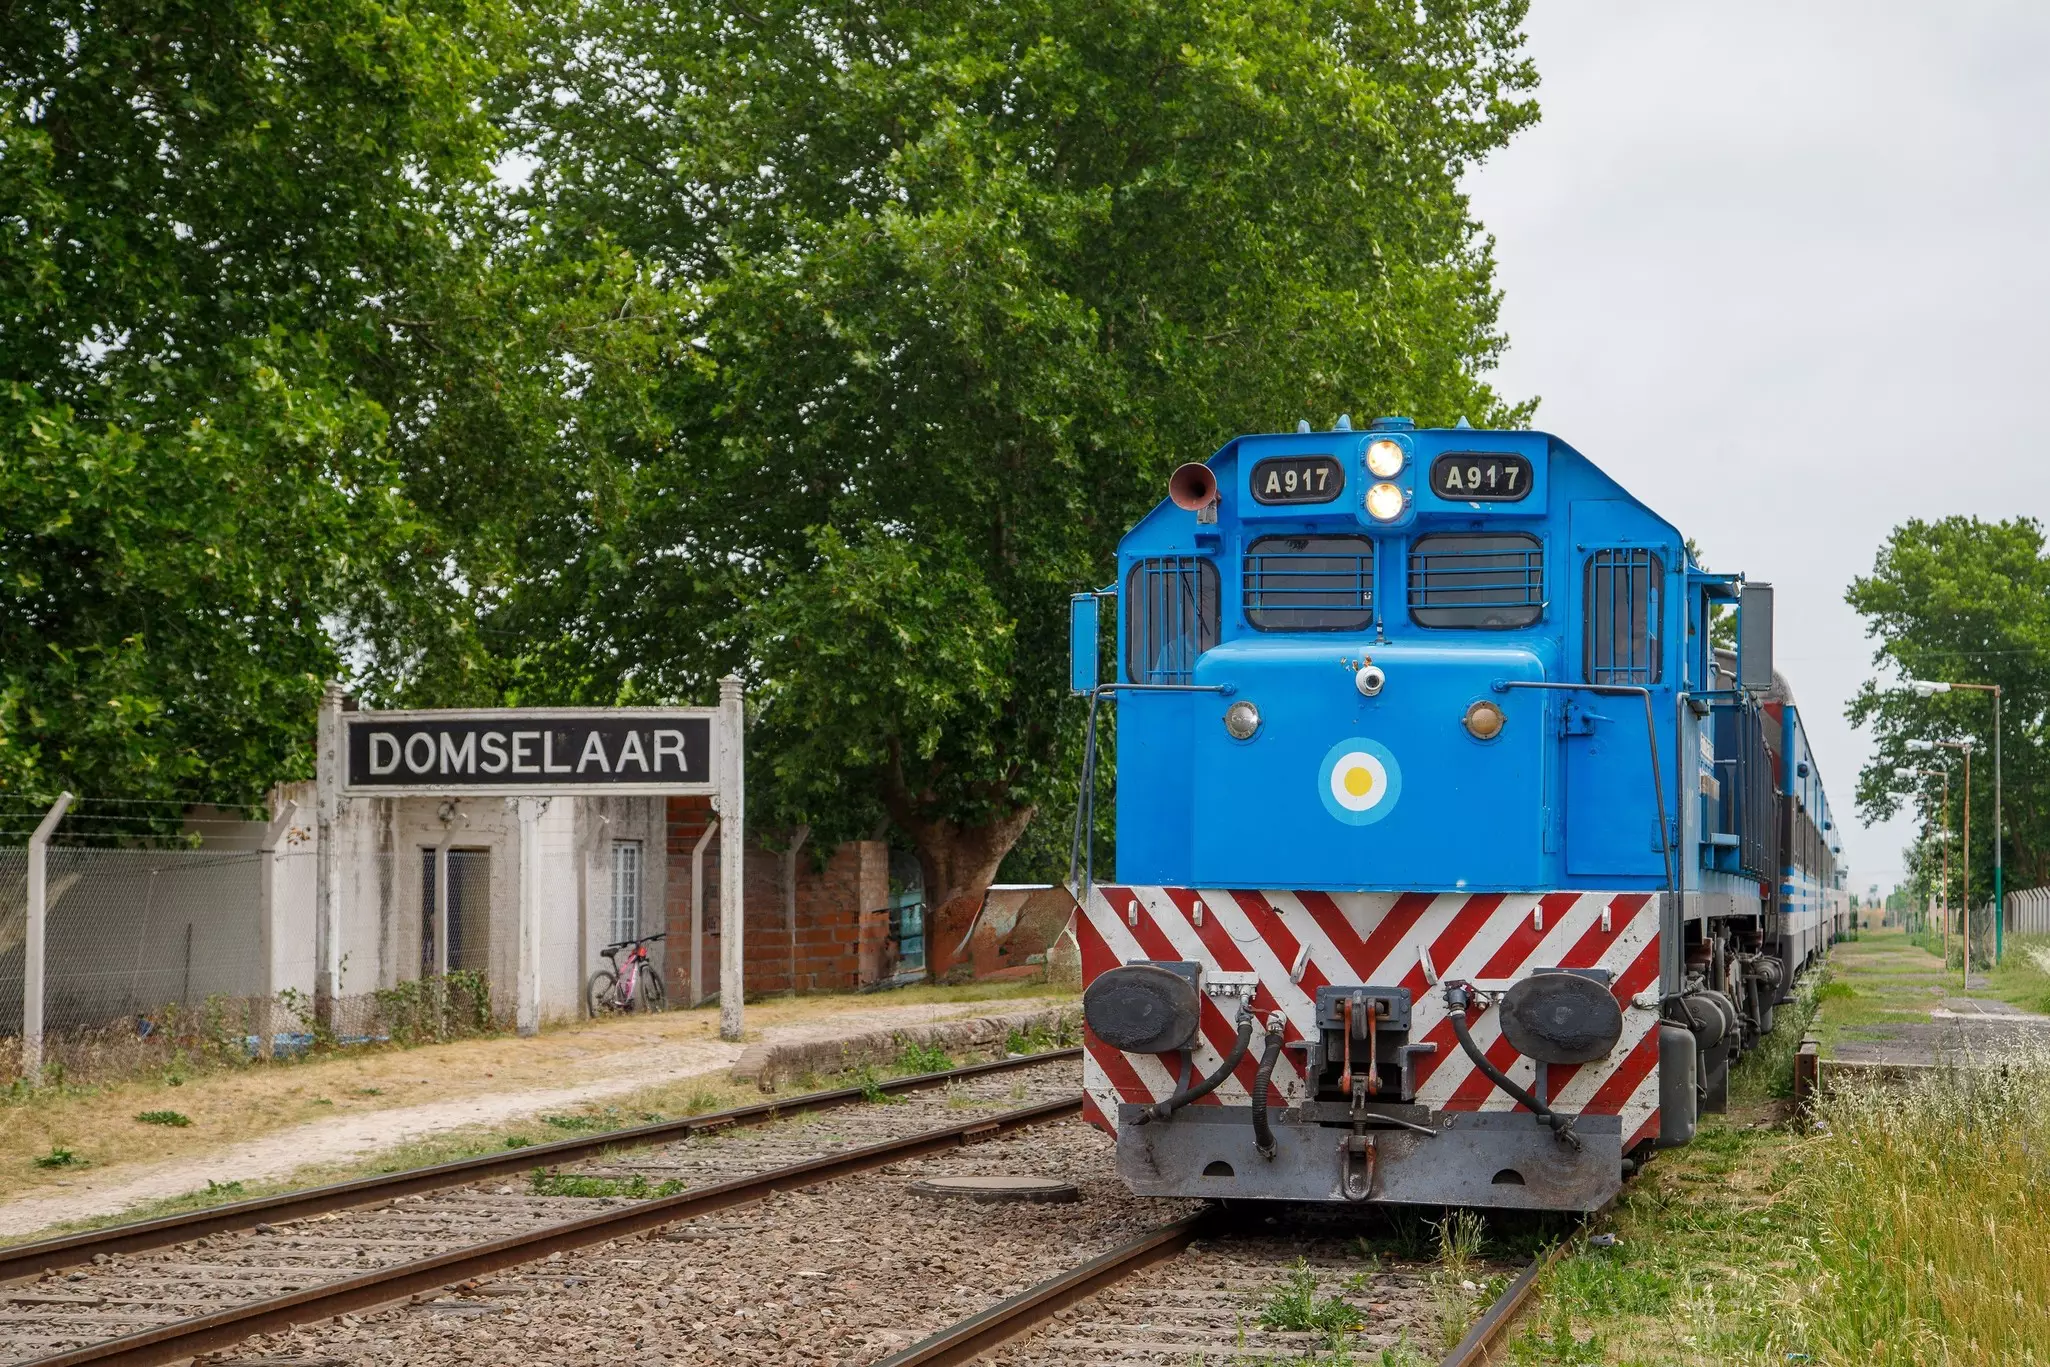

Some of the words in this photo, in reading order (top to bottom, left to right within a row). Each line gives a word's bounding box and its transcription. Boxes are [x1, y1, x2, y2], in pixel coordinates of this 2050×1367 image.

[1265, 468, 1329, 493] A917
[1446, 465, 1519, 490] A917
[369, 730, 689, 775] DOMSELAAR
